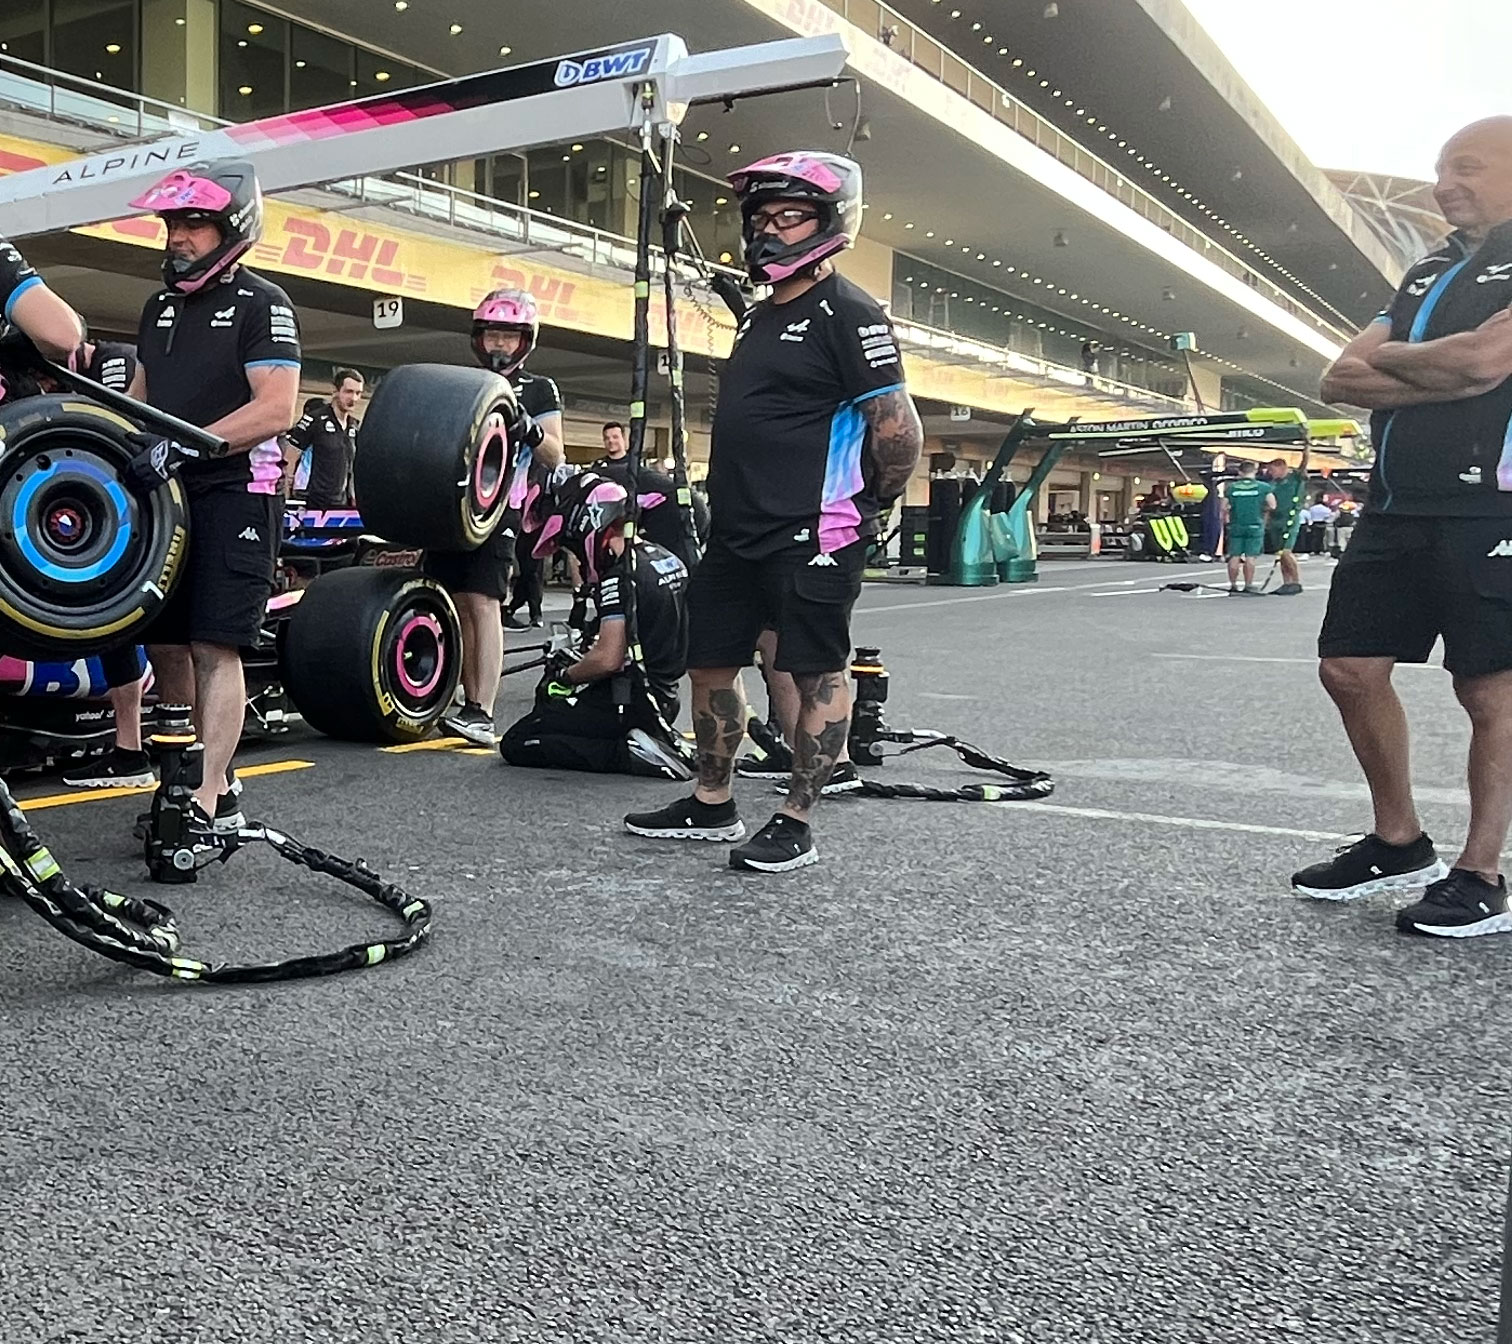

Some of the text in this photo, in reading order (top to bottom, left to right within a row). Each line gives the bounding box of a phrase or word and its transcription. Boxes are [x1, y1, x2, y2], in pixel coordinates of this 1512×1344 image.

[581, 49, 650, 82] BWT
[52, 141, 201, 185] ALPINE
[281, 216, 406, 287] DHL
[378, 300, 399, 318] 19
[1106, 421, 1149, 433] MARTIN
